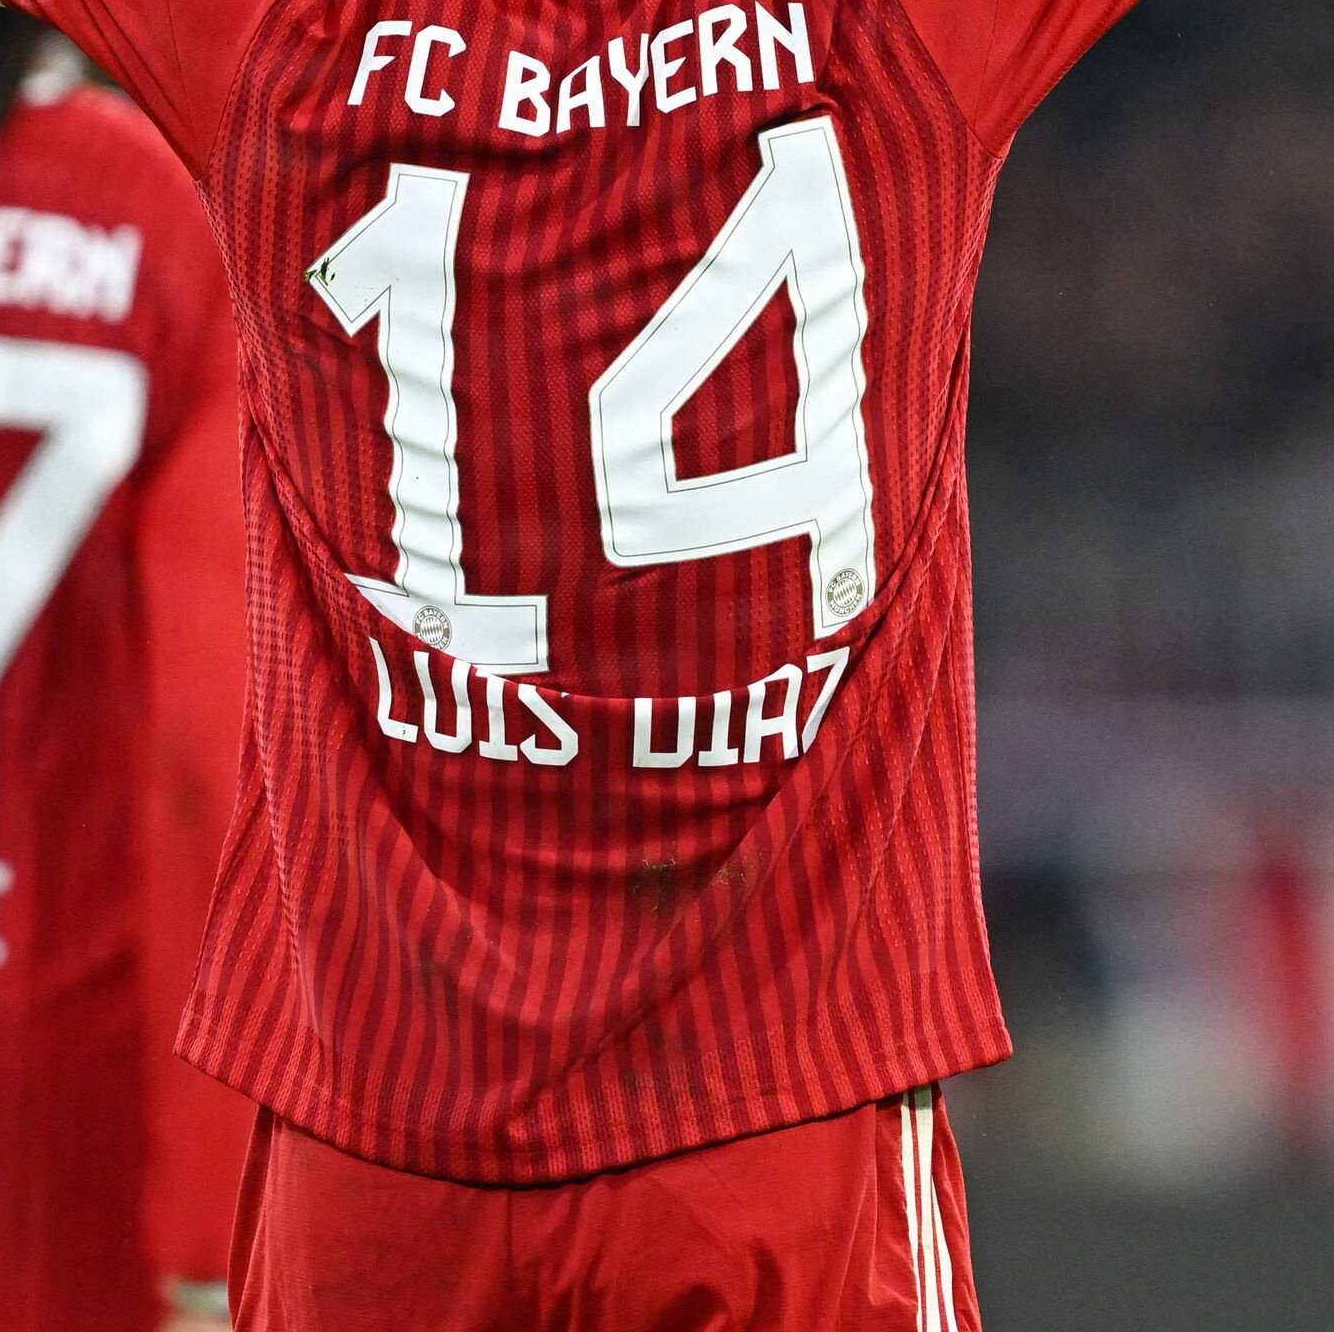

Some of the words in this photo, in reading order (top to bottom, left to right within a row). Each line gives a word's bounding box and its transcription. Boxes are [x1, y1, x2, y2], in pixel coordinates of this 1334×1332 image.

[347, 20, 467, 117] FC
[498, 1, 814, 138] BAYERN
[309, 116, 877, 675] 14
[369, 636, 579, 767] LUIS
